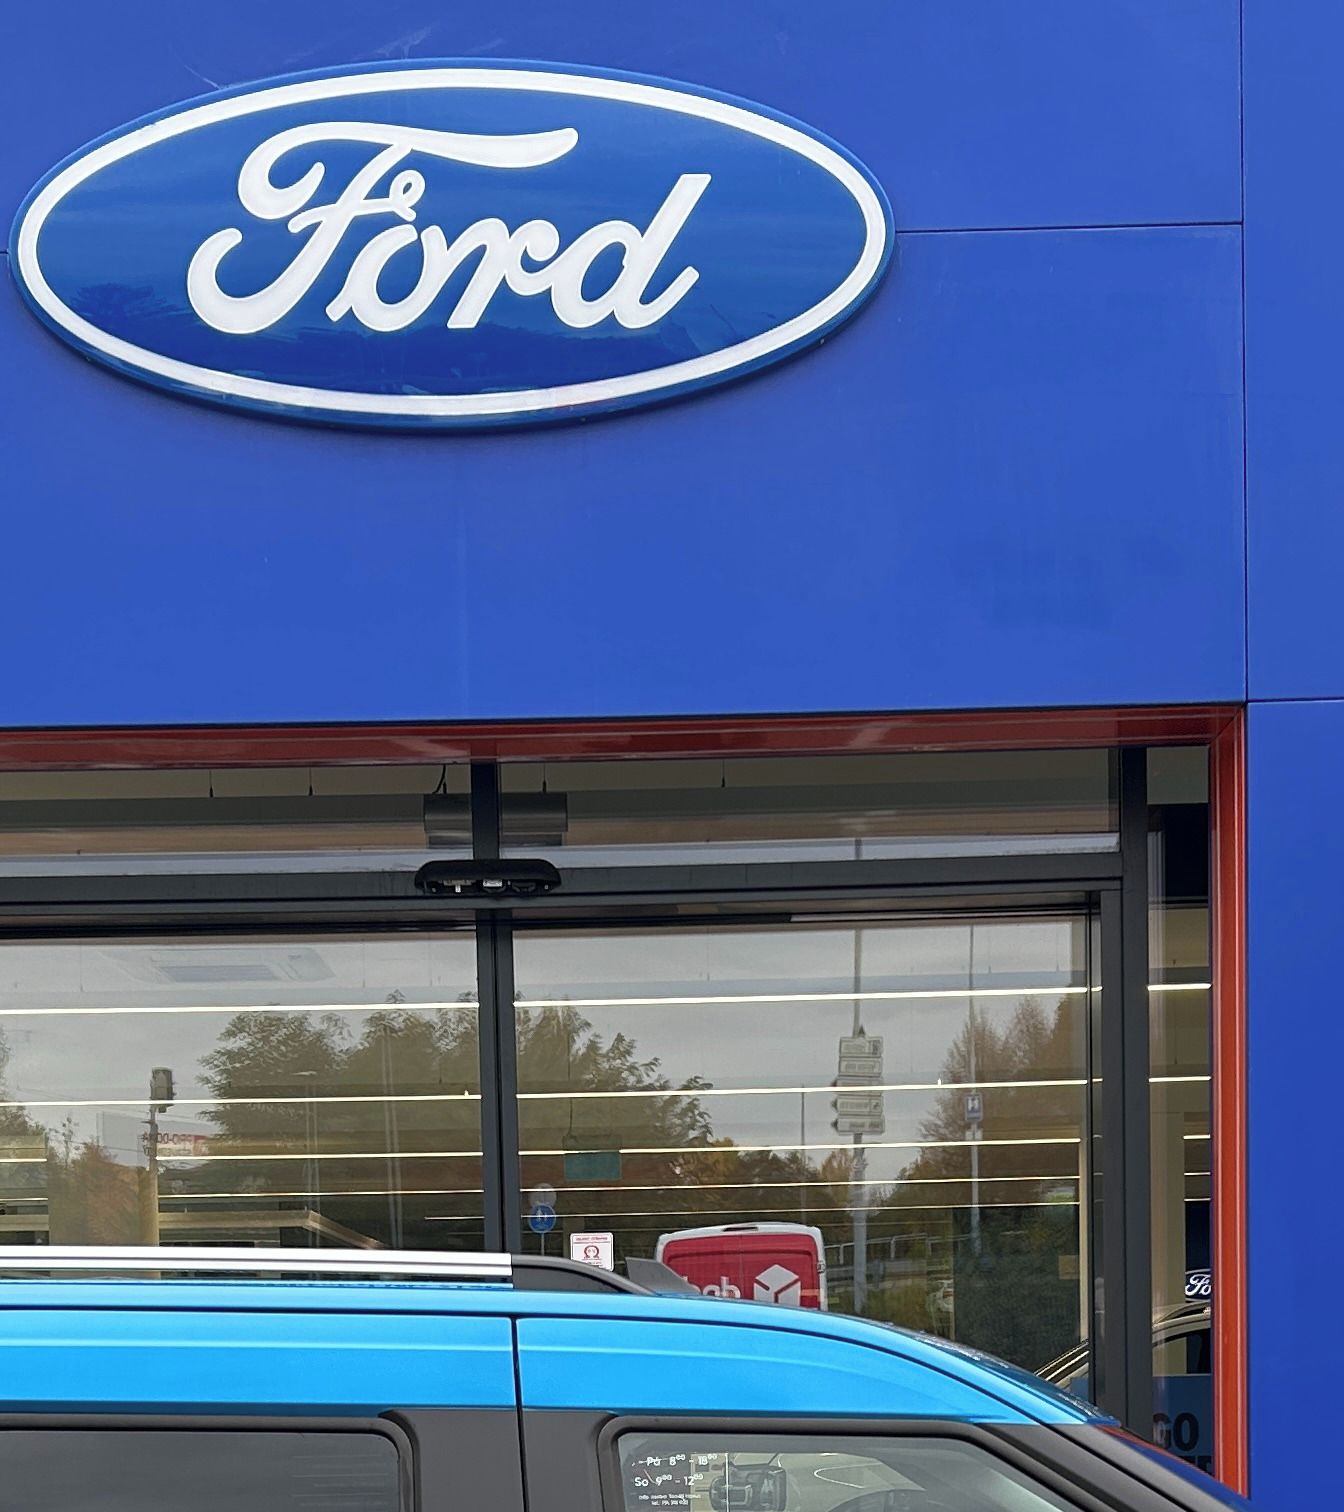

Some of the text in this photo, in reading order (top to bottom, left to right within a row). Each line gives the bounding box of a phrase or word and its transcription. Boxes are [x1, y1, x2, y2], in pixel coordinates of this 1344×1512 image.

[187, 121, 712, 334] Ford
[1185, 1273, 1212, 1296] Fo
[635, 1477, 649, 1487] So
